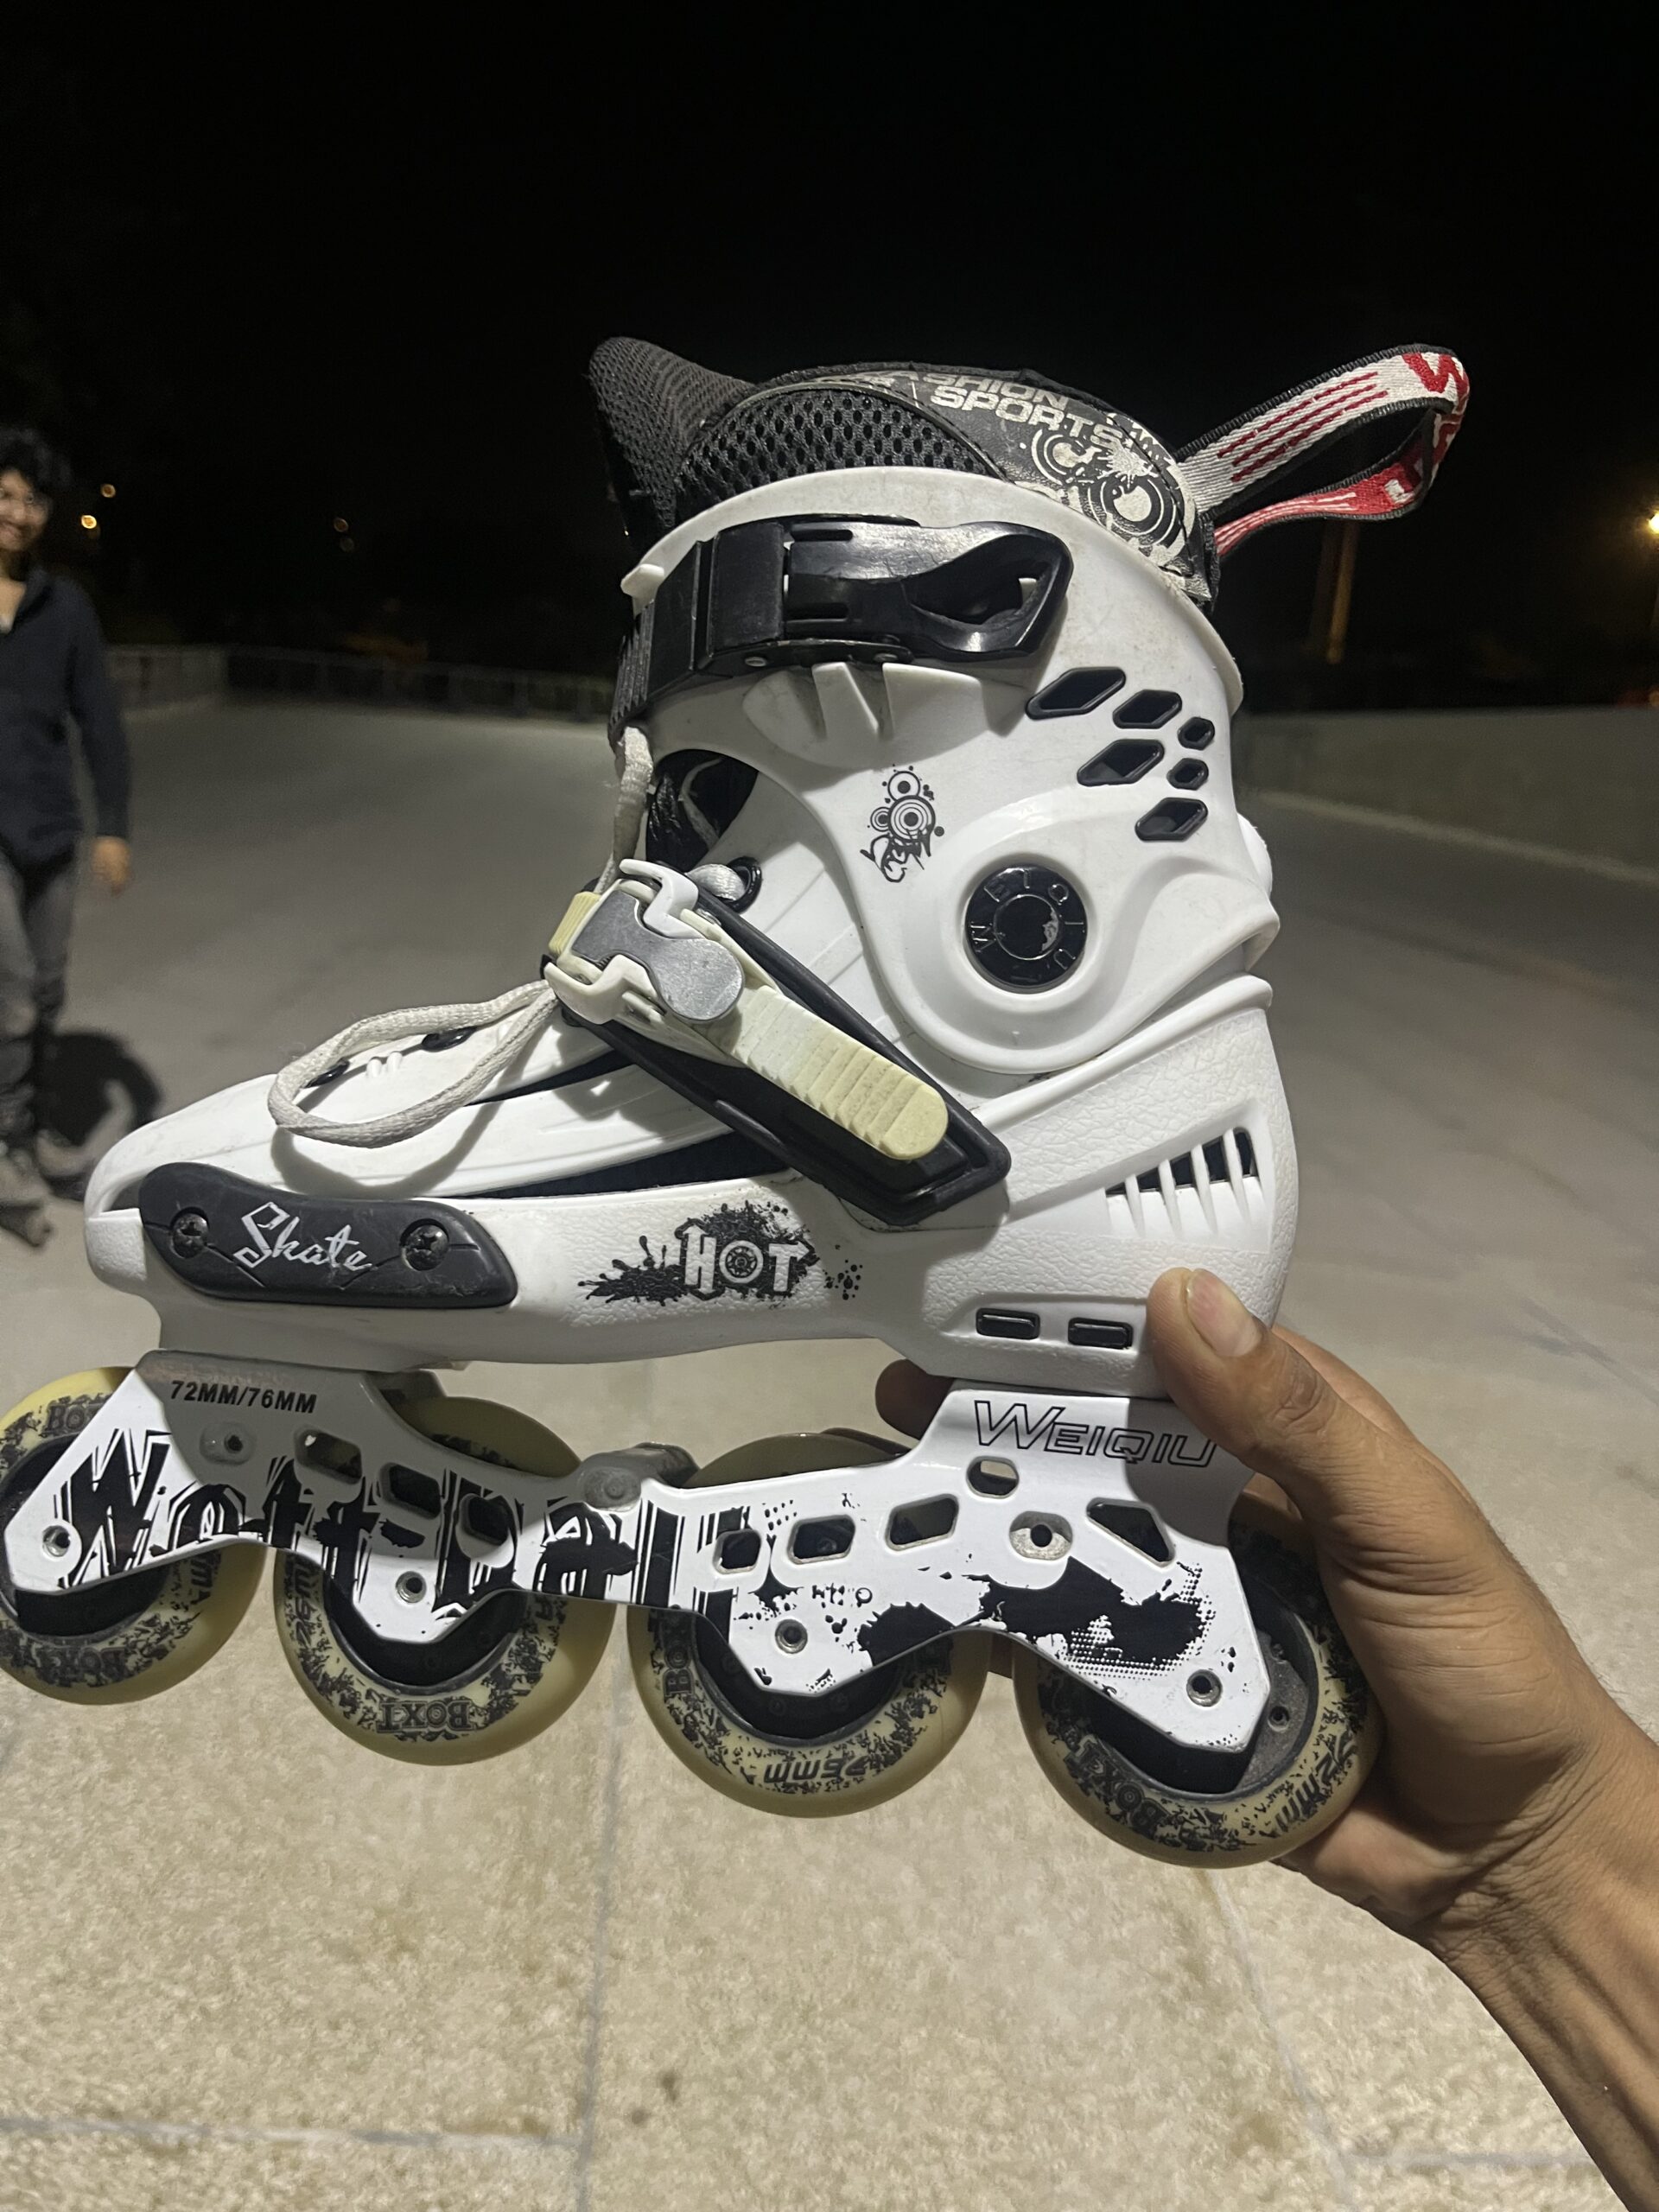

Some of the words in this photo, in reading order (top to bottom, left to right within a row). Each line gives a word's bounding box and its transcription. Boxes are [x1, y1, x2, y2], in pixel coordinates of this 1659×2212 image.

[930, 385, 1124, 453] SPORTS
[233, 1201, 372, 1271] Skate
[682, 1223, 810, 1294] HOT
[170, 1380, 317, 1414] 72MM/76MM
[974, 1400, 1217, 1467] WEIQIU
[377, 1700, 474, 1733] BOXT
